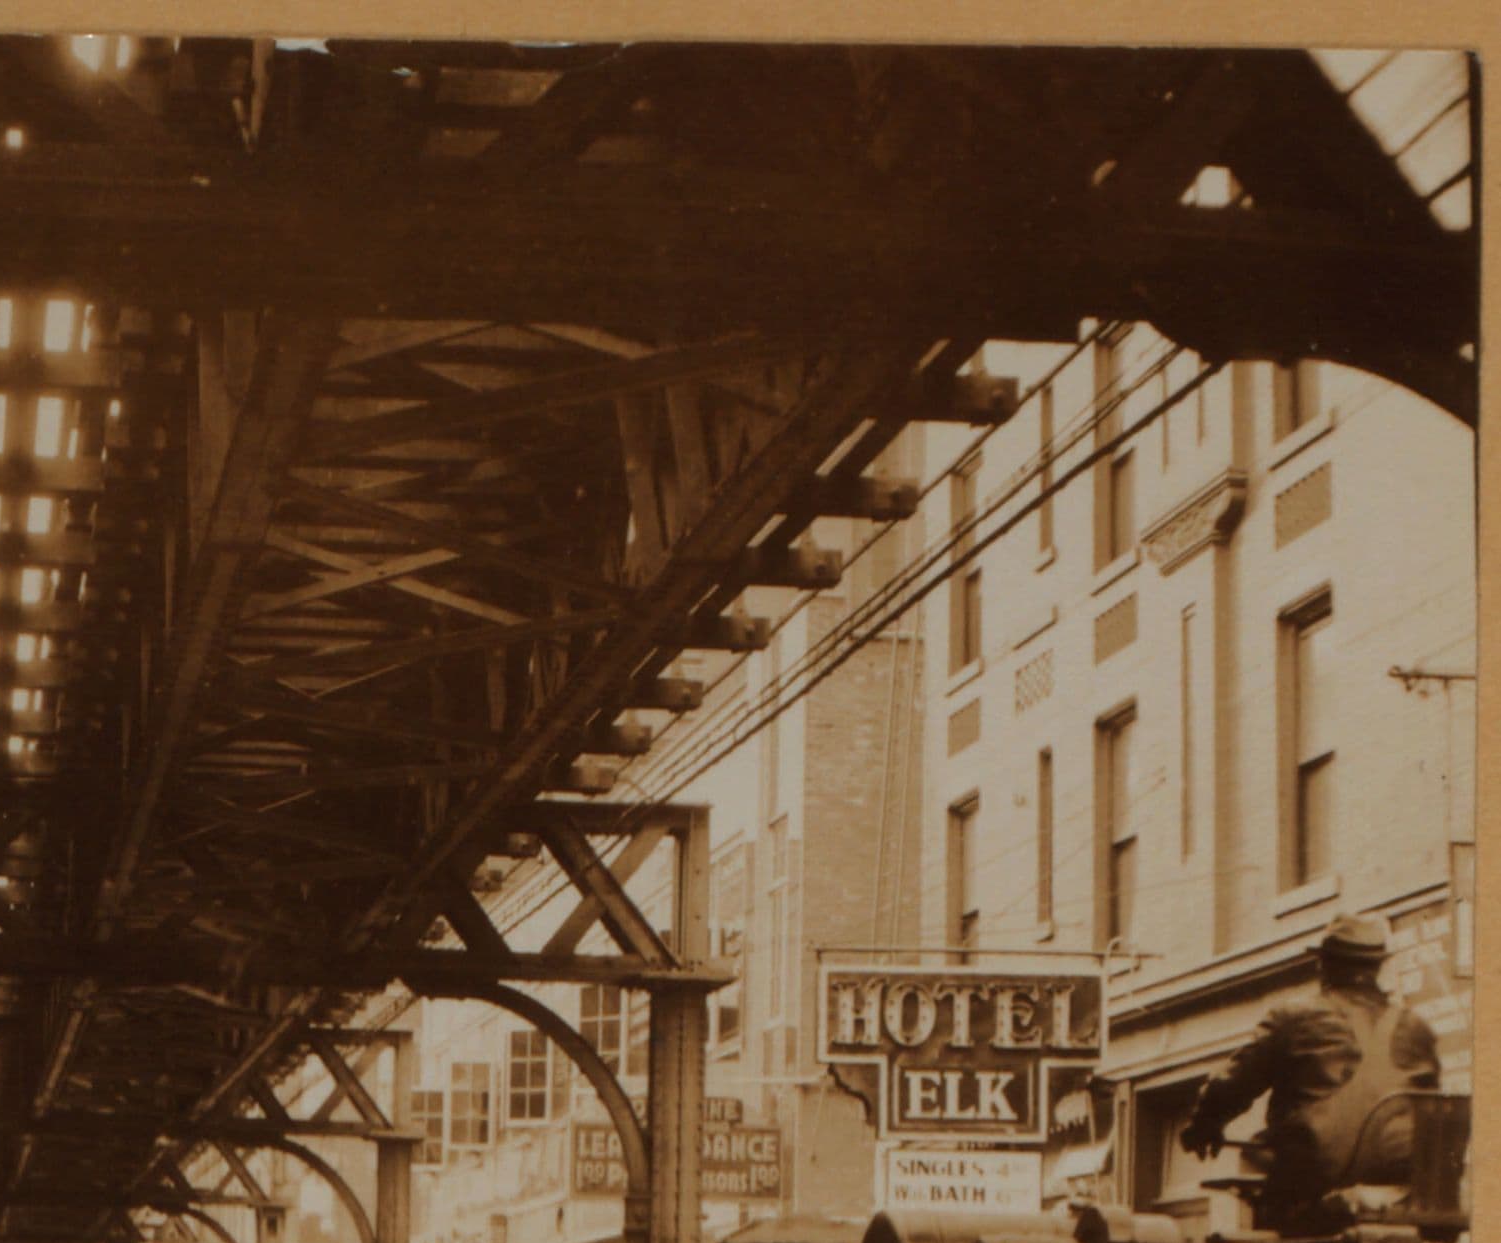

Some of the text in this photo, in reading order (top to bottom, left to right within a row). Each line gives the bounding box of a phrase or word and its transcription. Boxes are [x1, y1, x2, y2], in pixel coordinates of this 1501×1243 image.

[830, 980, 1097, 1050] HOTEL
[904, 1069, 1018, 1122] ELK
[578, 1130, 624, 1159] LEA
[896, 1158, 986, 1177] SINGLES
[929, 1184, 987, 1204] BATH
